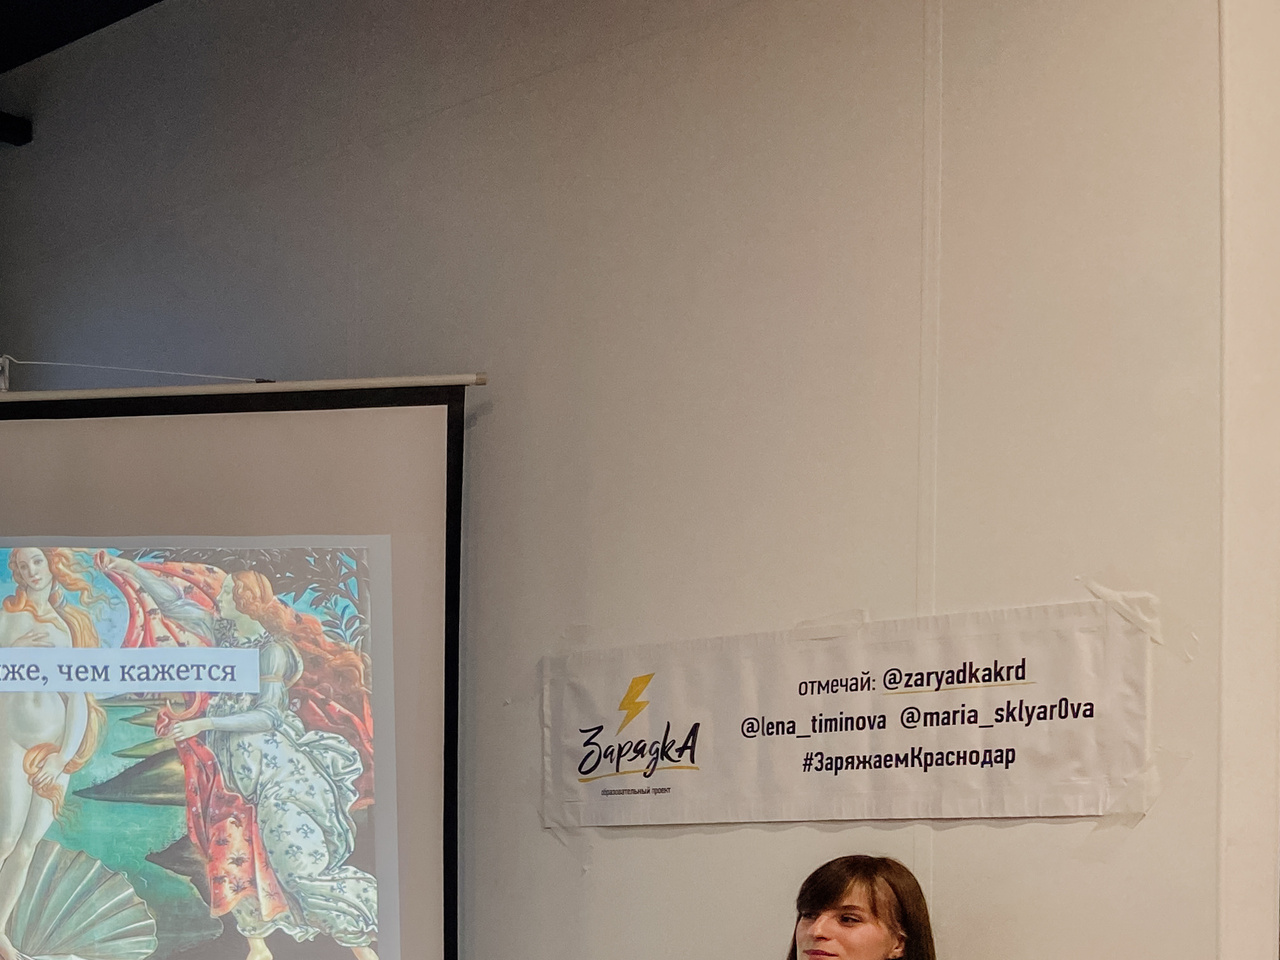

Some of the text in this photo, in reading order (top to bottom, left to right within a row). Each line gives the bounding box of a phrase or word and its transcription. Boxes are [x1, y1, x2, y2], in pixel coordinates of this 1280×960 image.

[57, 662, 111, 682] чем
[120, 662, 237, 682] кажется
[798, 657, 1027, 697] отмечай: @zaryadkakrd
[741, 697, 1095, 739] @lena_timinova @maria_sklyar0va
[802, 746, 1016, 777] #ЗаряжаемКраснодар
[601, 786, 672, 797] образовательный проект
